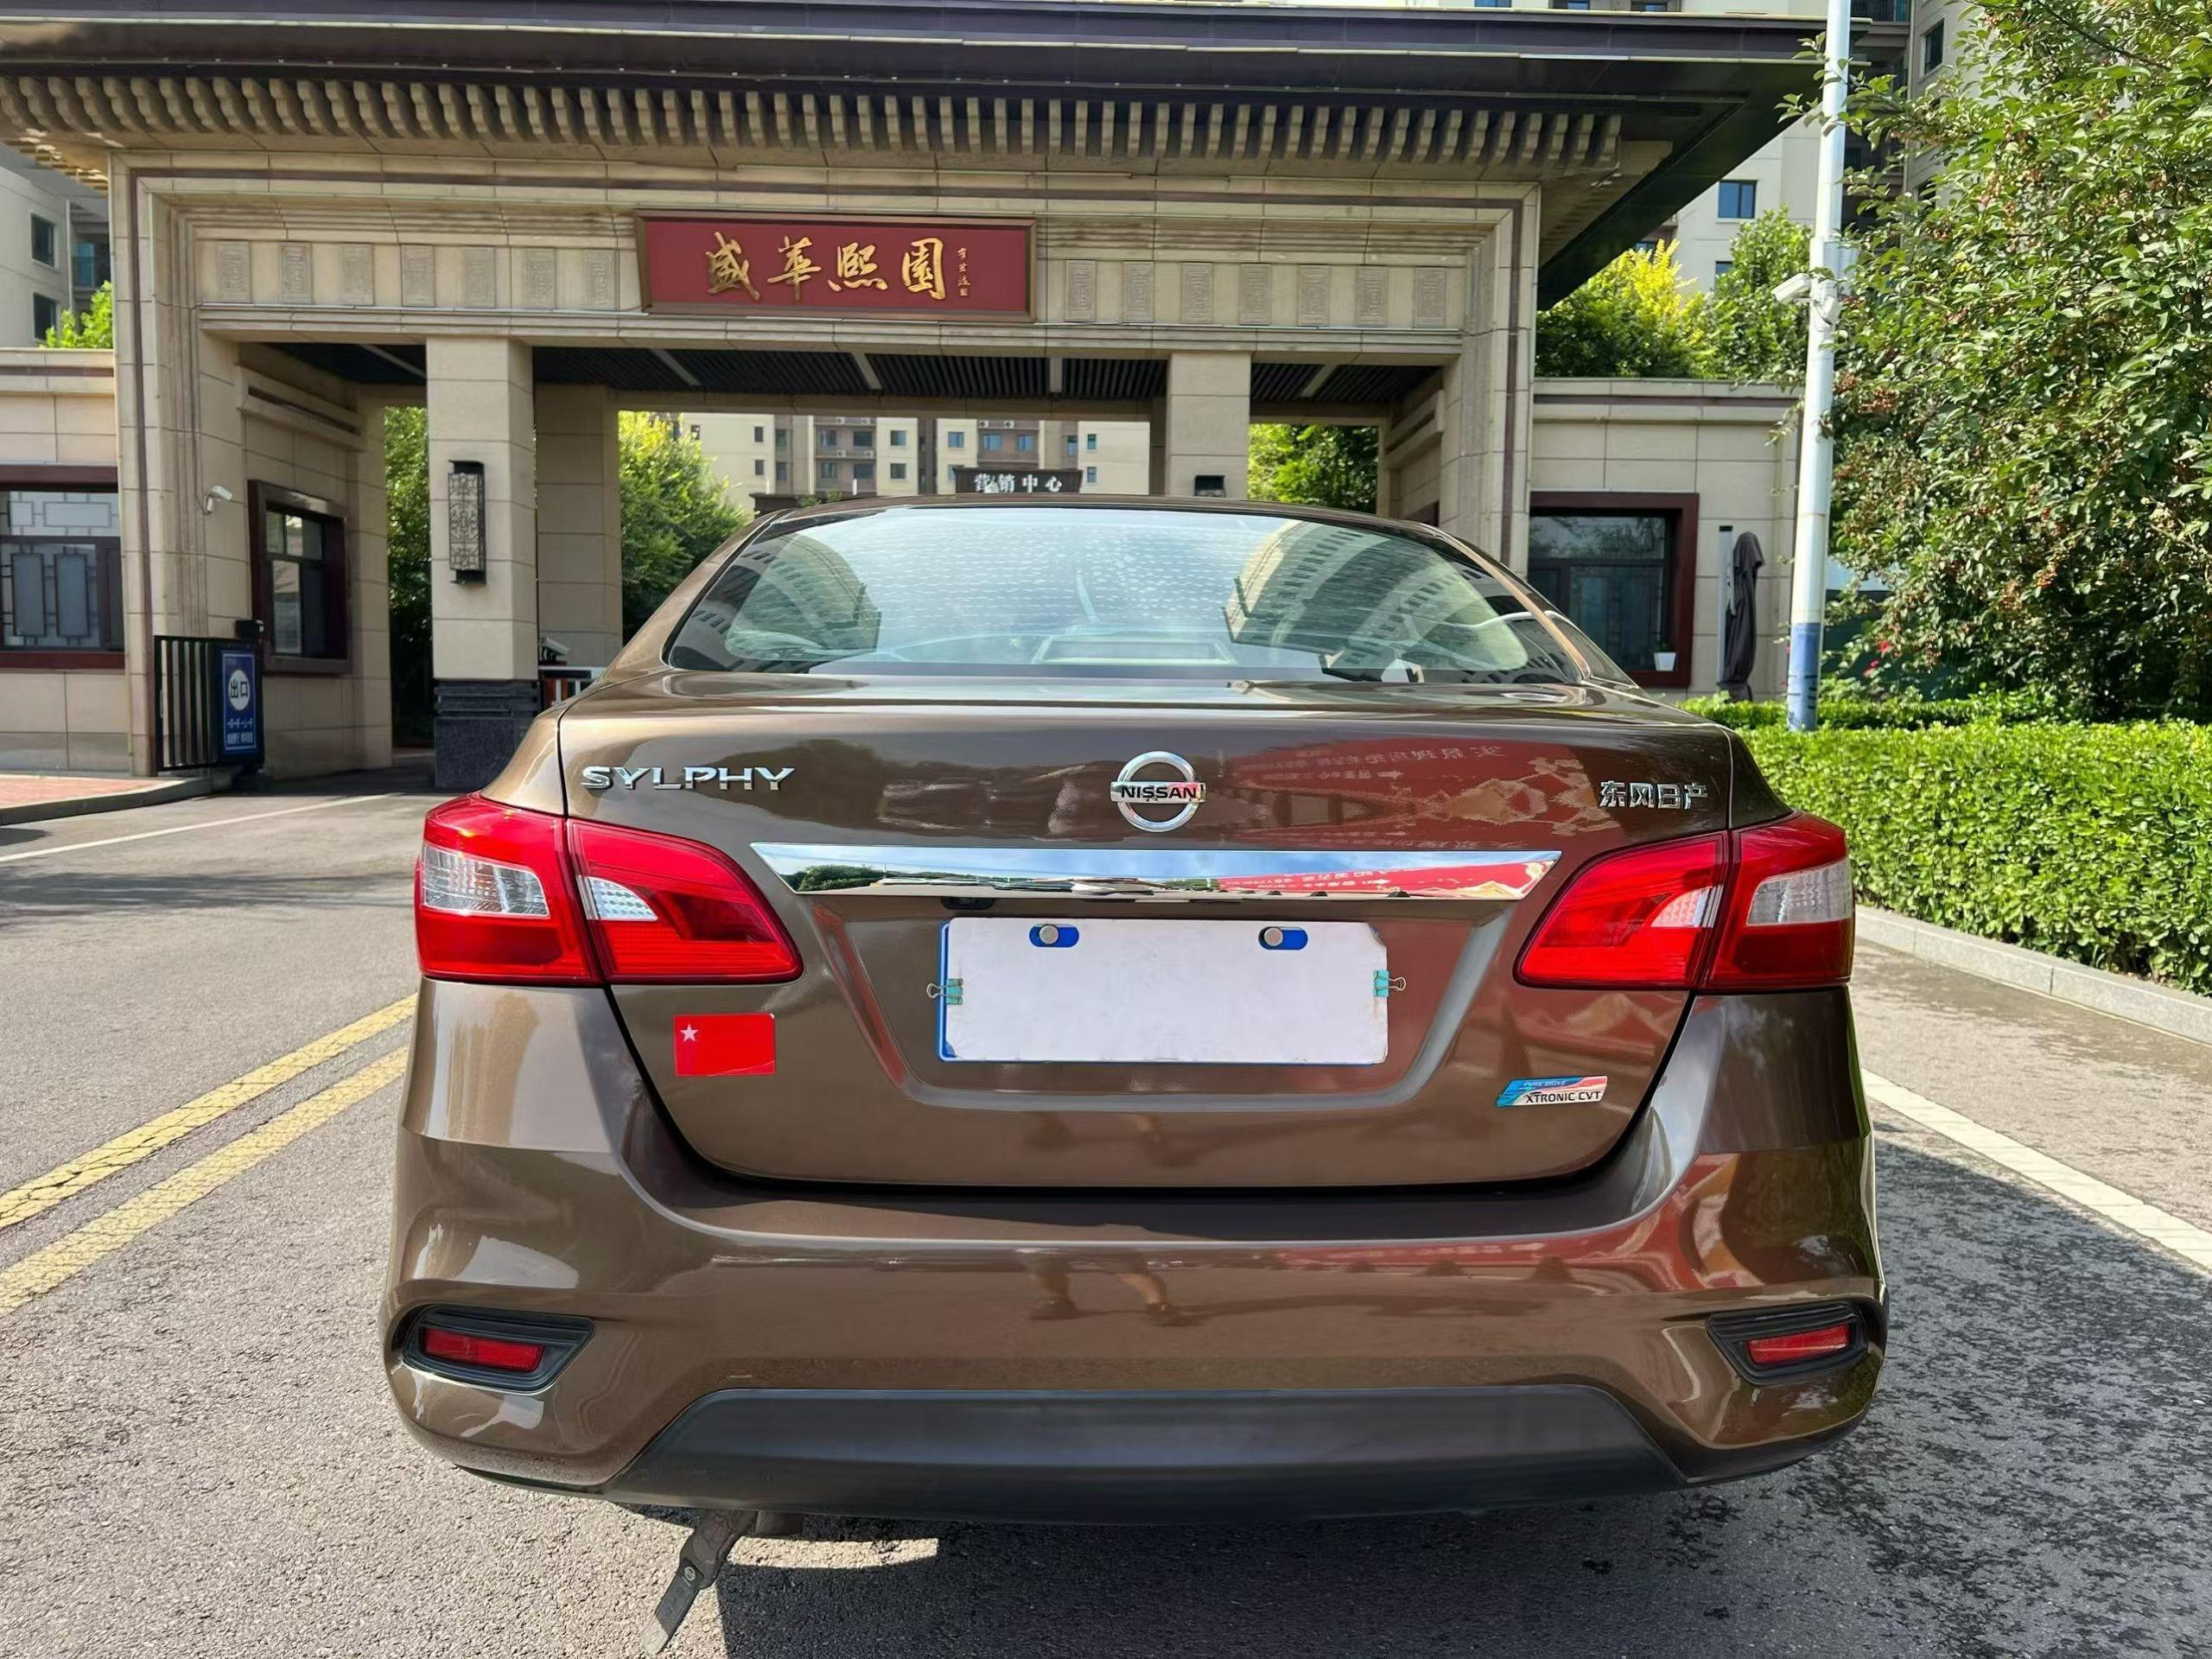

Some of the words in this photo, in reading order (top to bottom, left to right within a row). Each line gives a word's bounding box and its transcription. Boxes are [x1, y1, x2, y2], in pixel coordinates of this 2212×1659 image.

[231, 678, 248, 698] 出口
[581, 766, 795, 791] SYLPHY
[1121, 785, 1198, 799] NISSAN
[1599, 780, 1708, 810] 东风日产
[1526, 1091, 1575, 1103] XTRONIC
[1578, 1090, 1601, 1101] CVT
